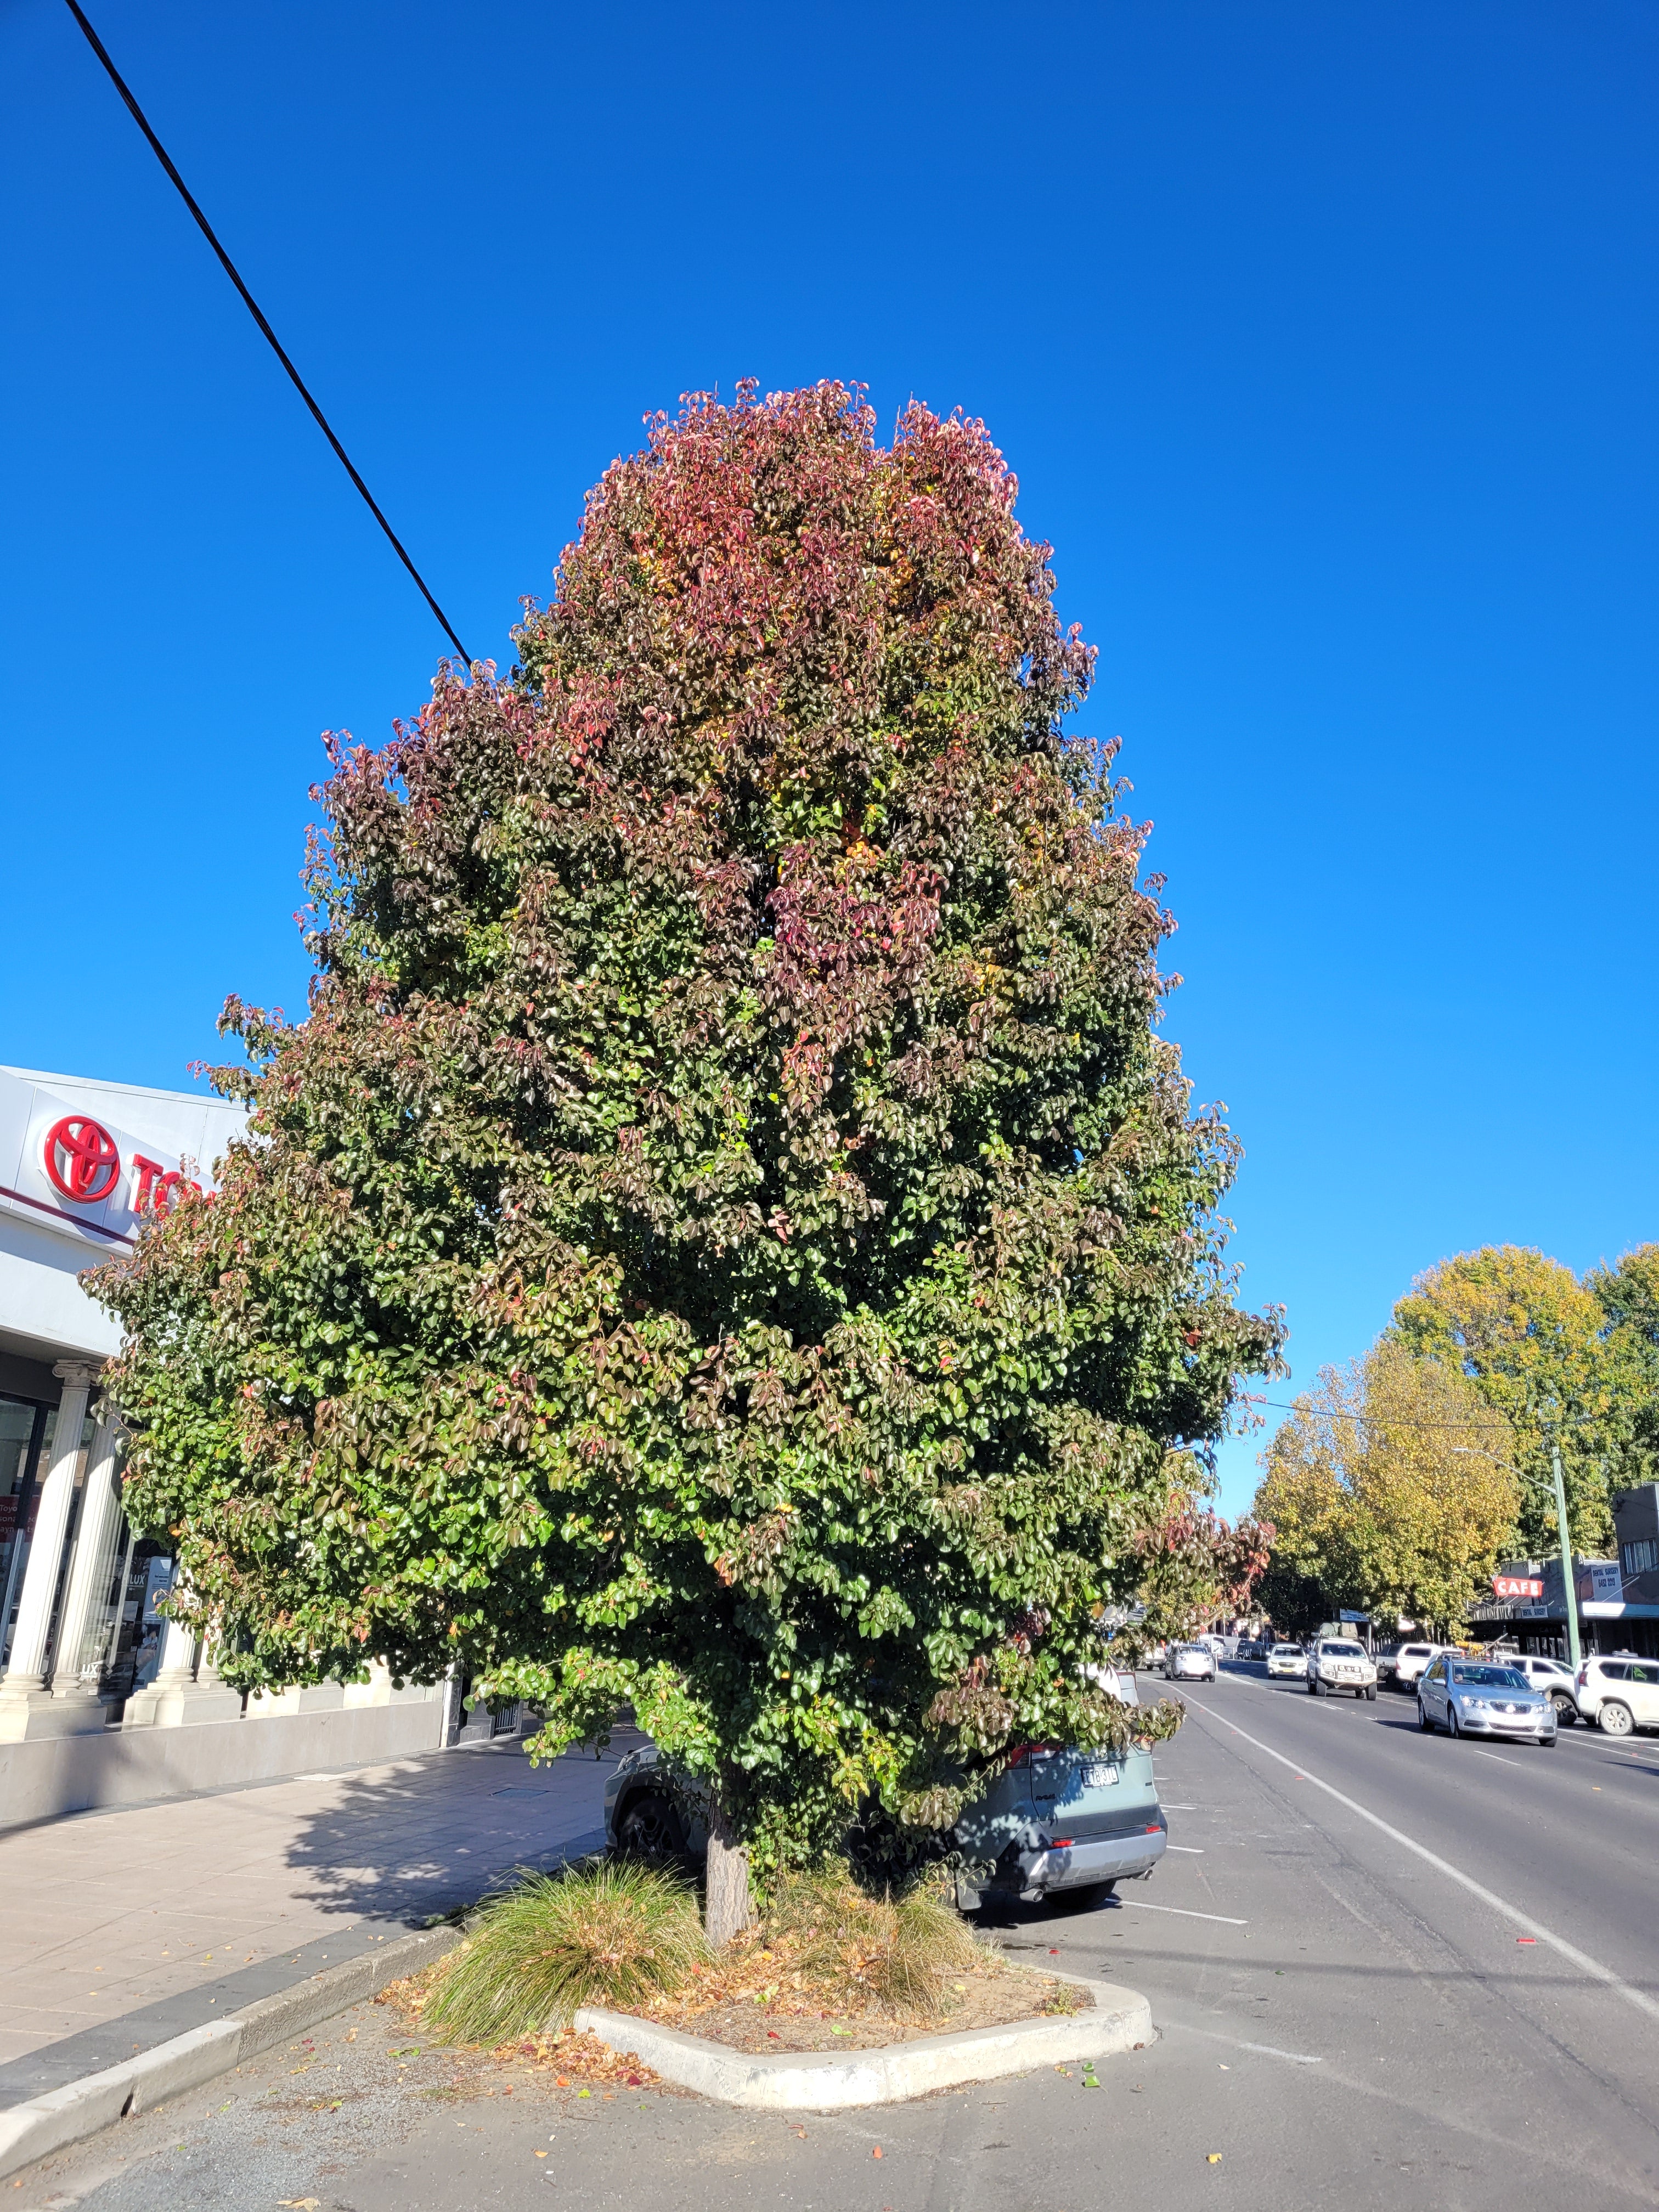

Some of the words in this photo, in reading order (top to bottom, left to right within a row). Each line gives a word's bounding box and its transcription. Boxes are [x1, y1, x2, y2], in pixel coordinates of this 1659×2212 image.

[0, 1505, 18, 1513] Toyo
[1498, 1581, 1538, 1595] CAFE
[82, 1664, 98, 1674] UX
